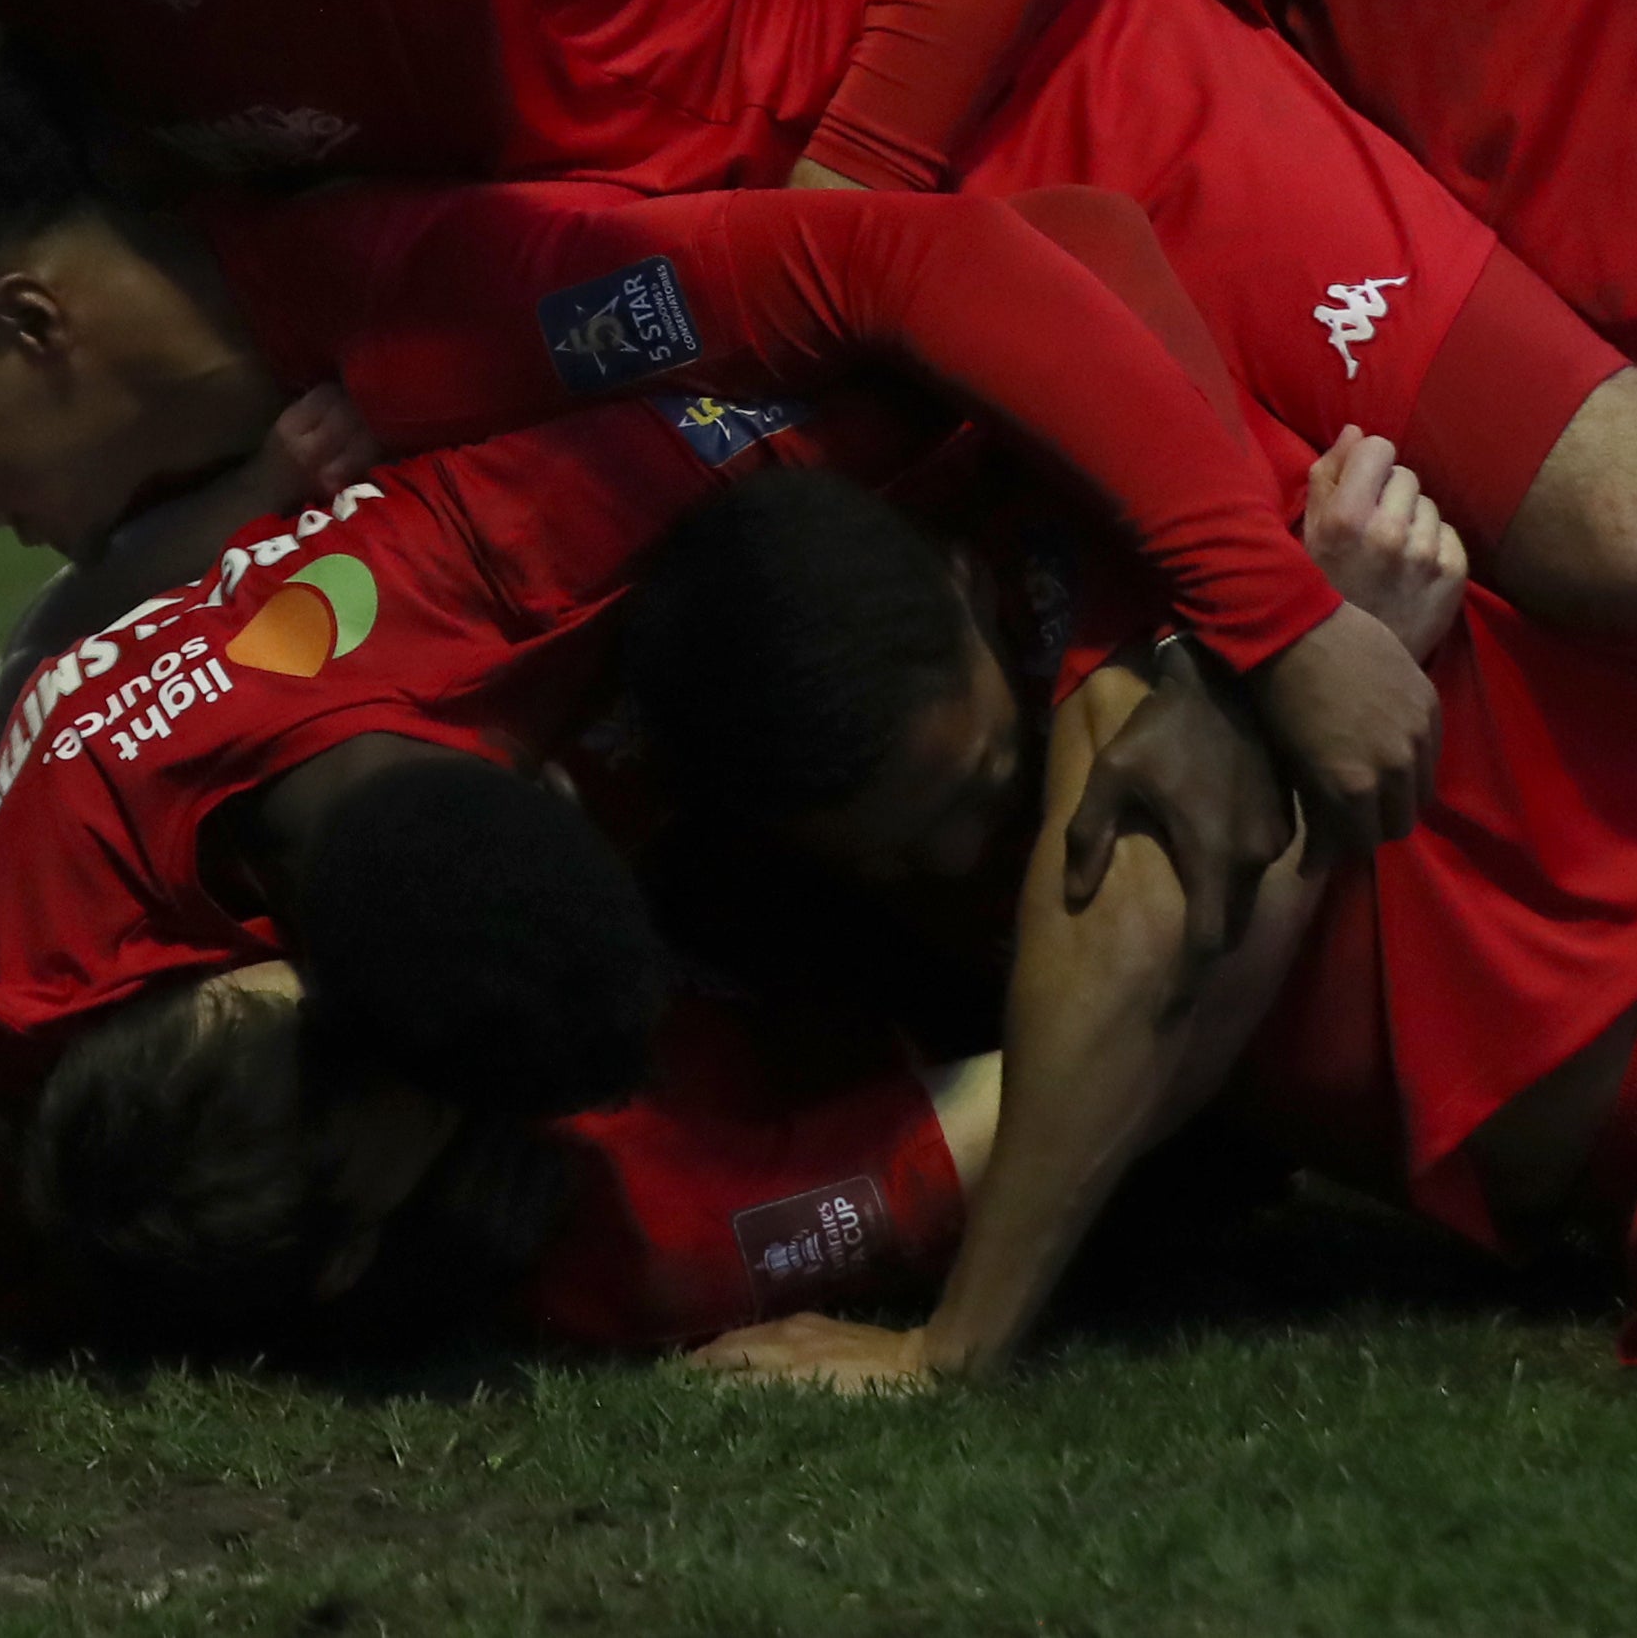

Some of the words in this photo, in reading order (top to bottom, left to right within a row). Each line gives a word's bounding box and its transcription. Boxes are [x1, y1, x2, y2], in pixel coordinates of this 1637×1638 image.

[623, 273, 662, 341] STAR
[656, 263, 697, 351] CONSERVATORIES
[649, 345, 672, 362] 5
[42, 635, 210, 765] source.
[110, 657, 234, 762] light
[833, 1196, 863, 1244] CUP
